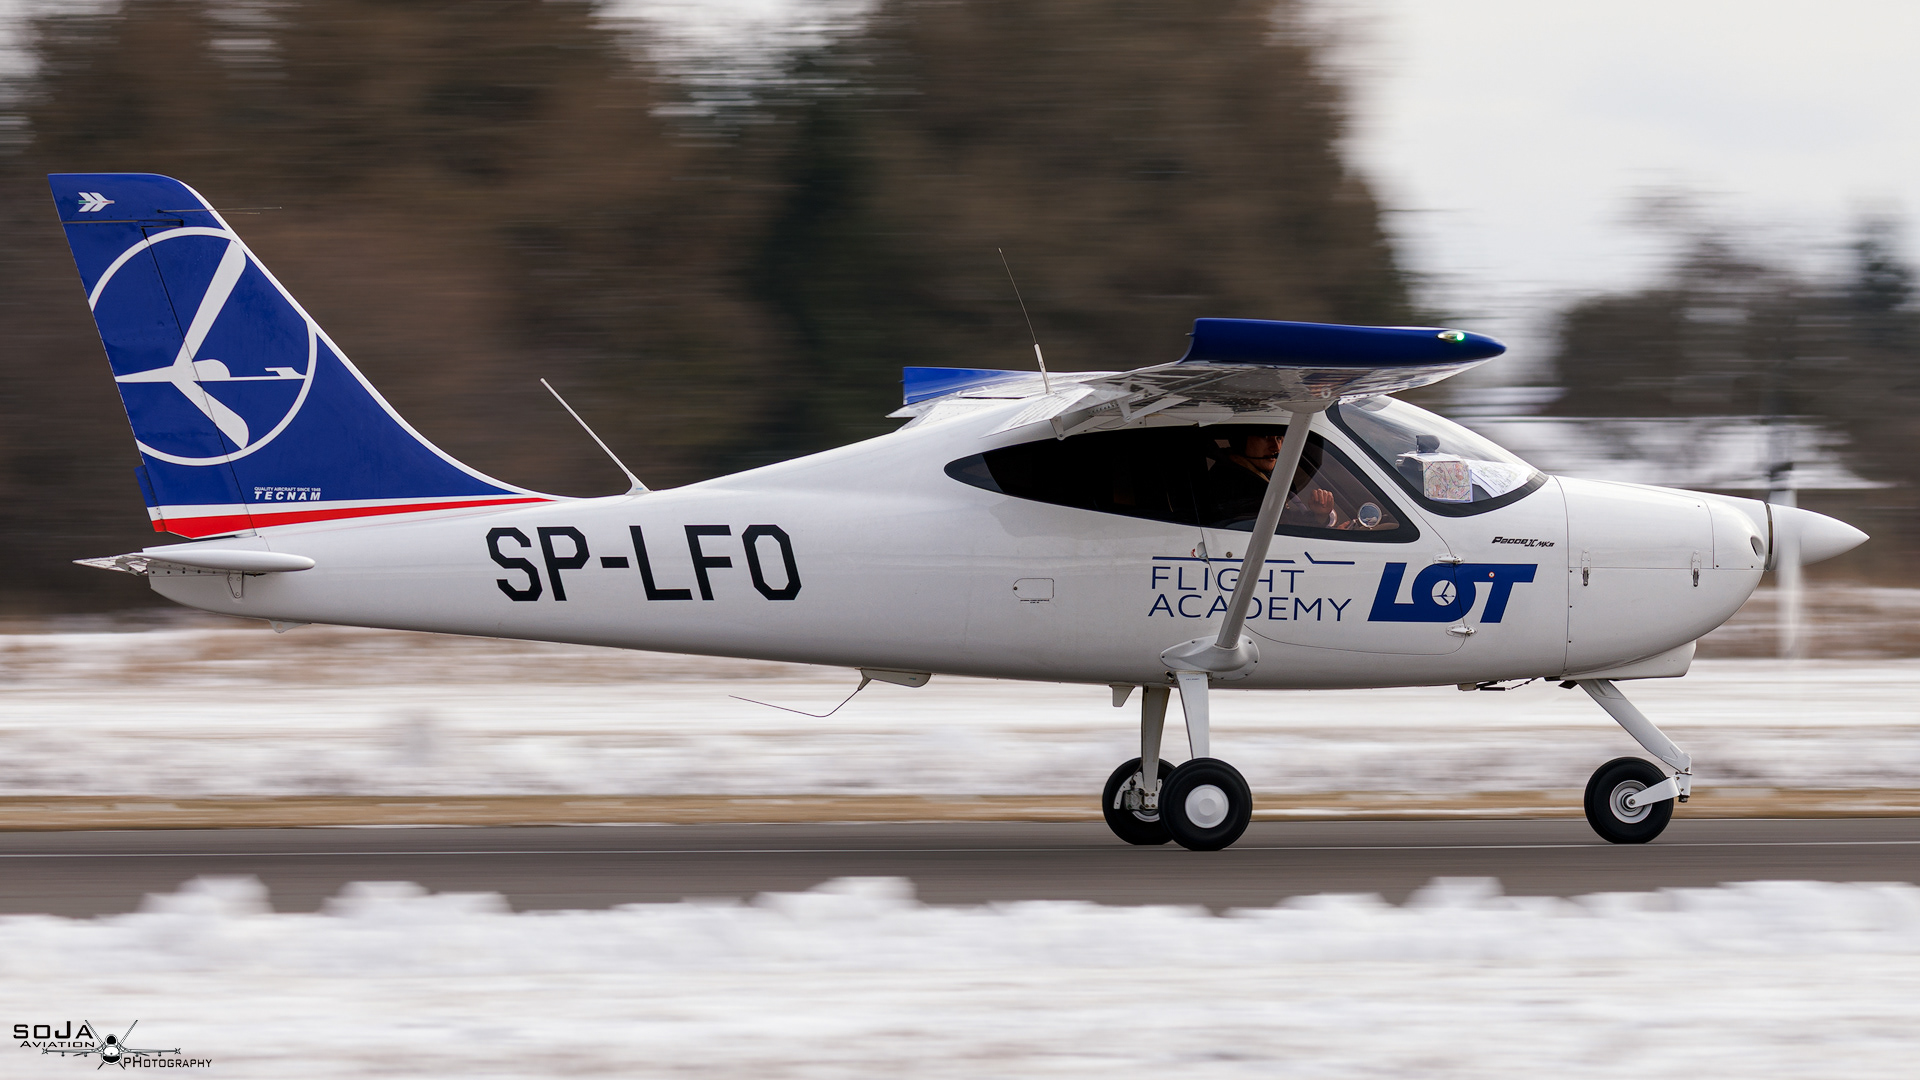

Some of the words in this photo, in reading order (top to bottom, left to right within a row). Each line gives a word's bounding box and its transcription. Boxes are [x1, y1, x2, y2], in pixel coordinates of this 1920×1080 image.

[254, 491, 321, 501] TECNAM
[486, 524, 802, 601] SP-LFO
[1367, 562, 1538, 623] LOT
